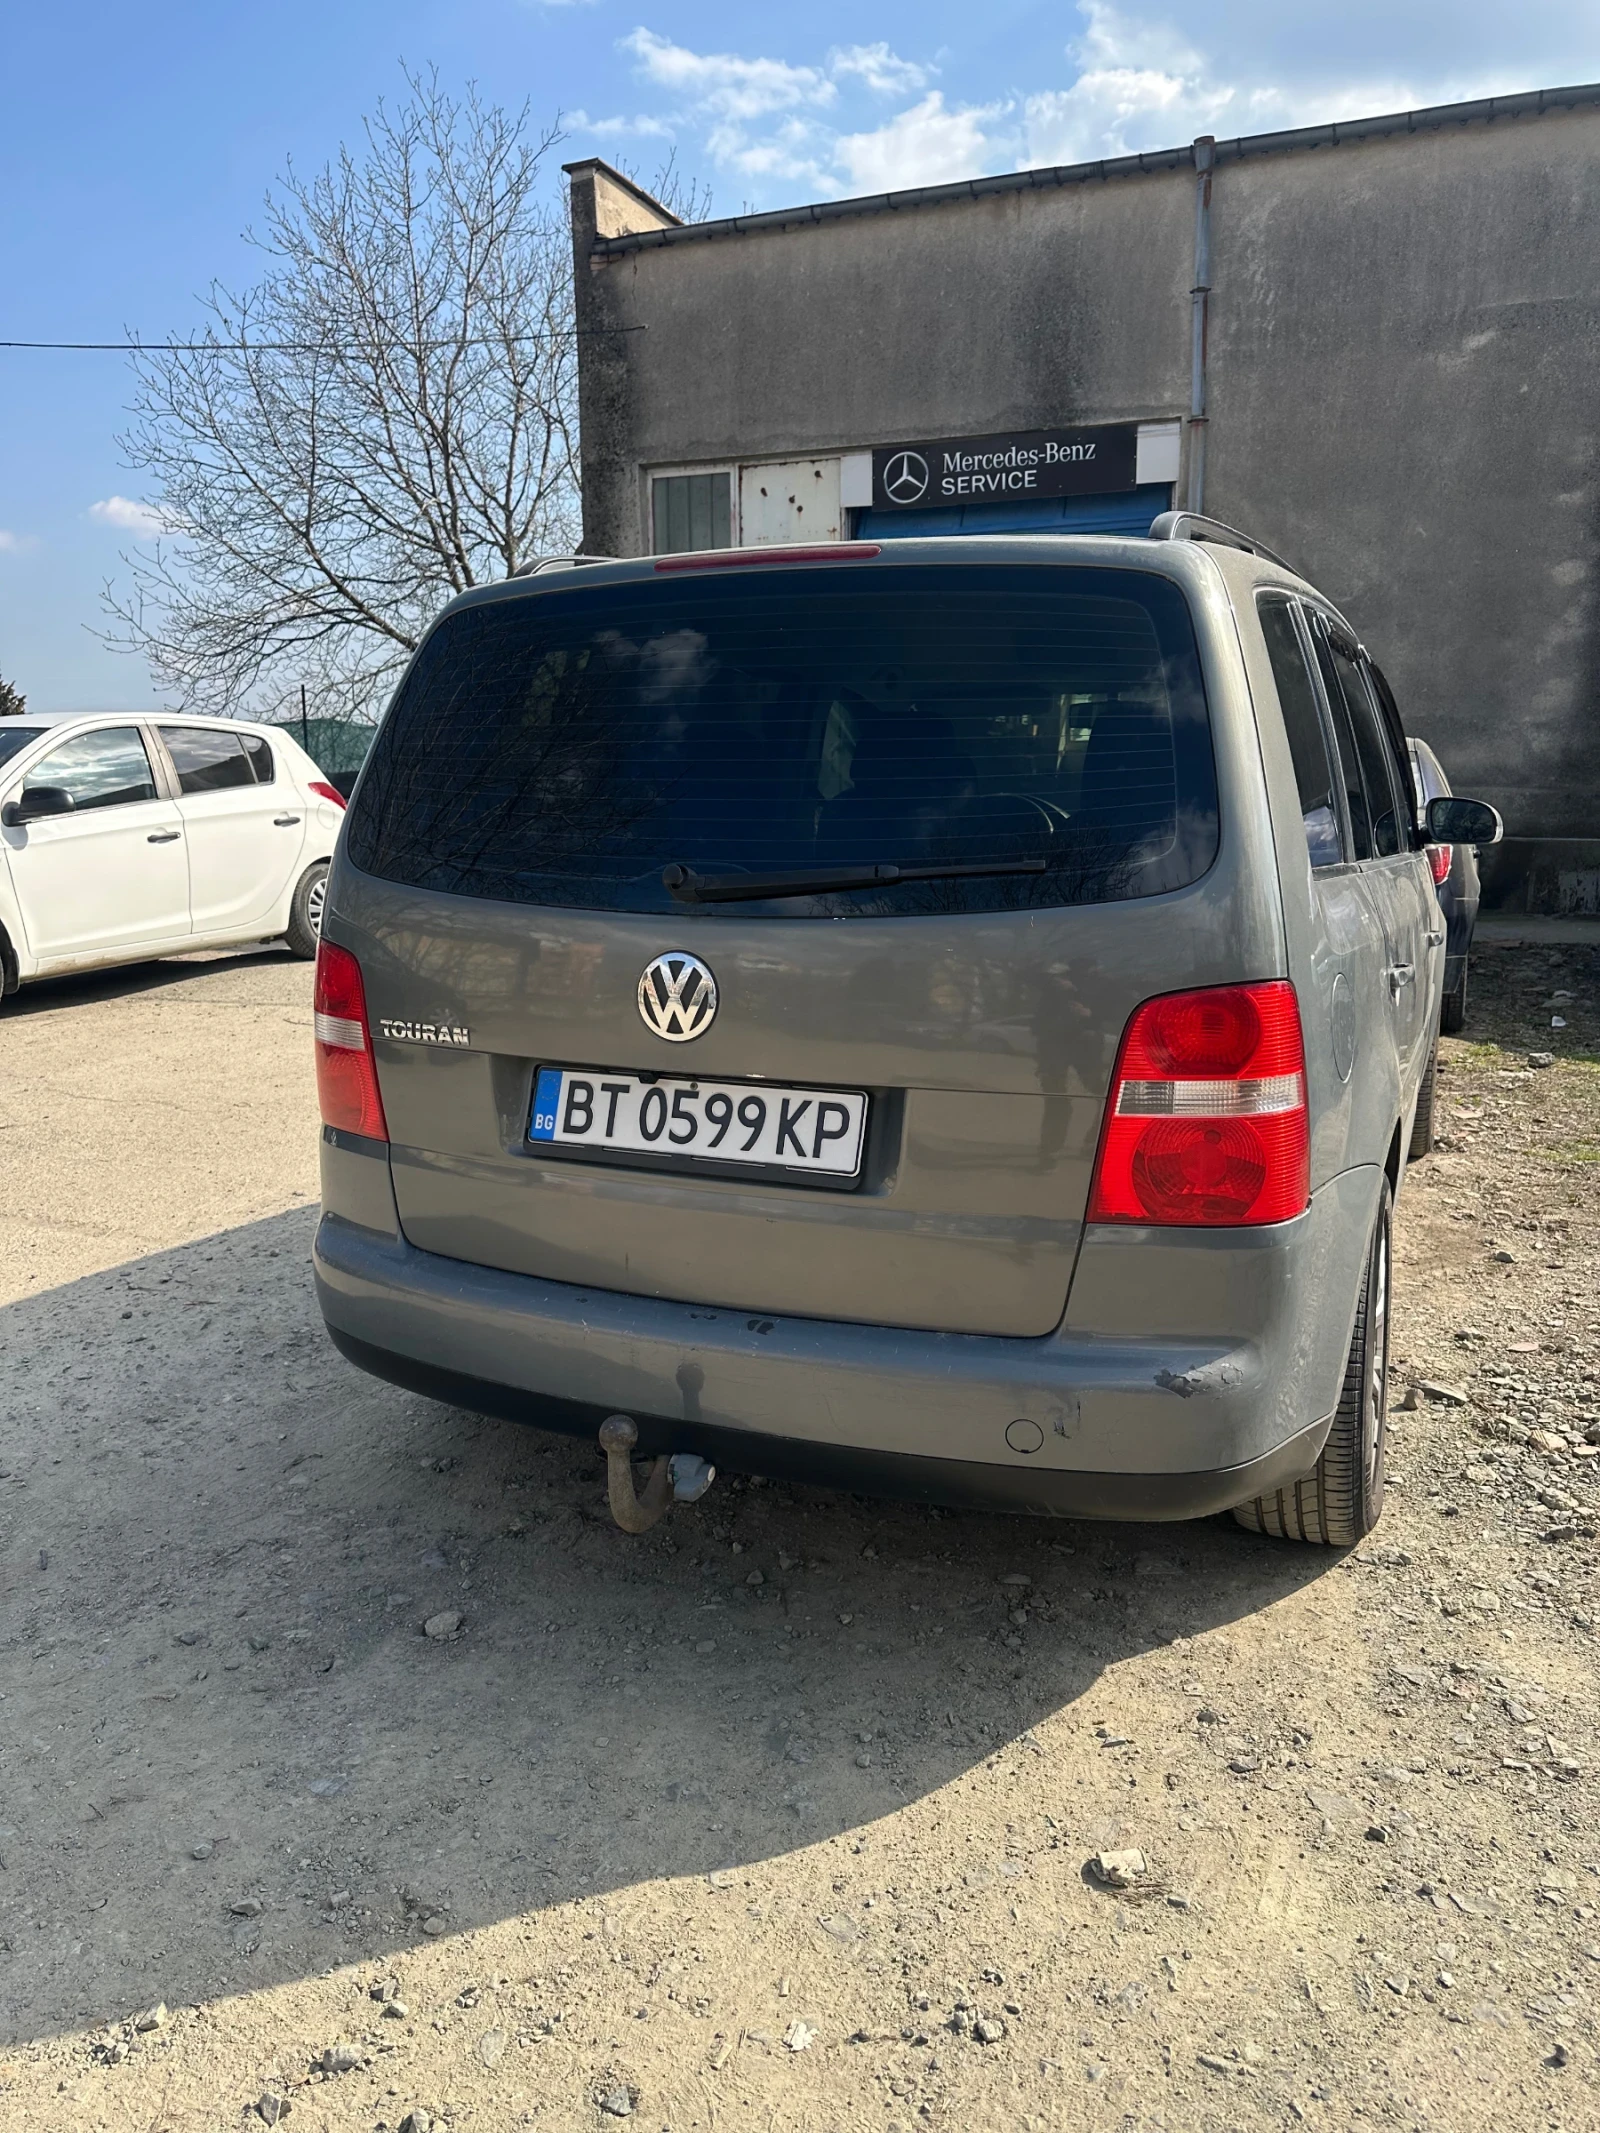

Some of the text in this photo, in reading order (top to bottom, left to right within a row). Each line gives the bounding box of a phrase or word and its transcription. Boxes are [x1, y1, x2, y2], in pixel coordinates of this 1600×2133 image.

[942, 442, 1097, 474] Mercedes-Benz
[941, 470, 1038, 496] SERVICE
[380, 1018, 471, 1046] TOURAN
[534, 1113, 554, 1131] BG
